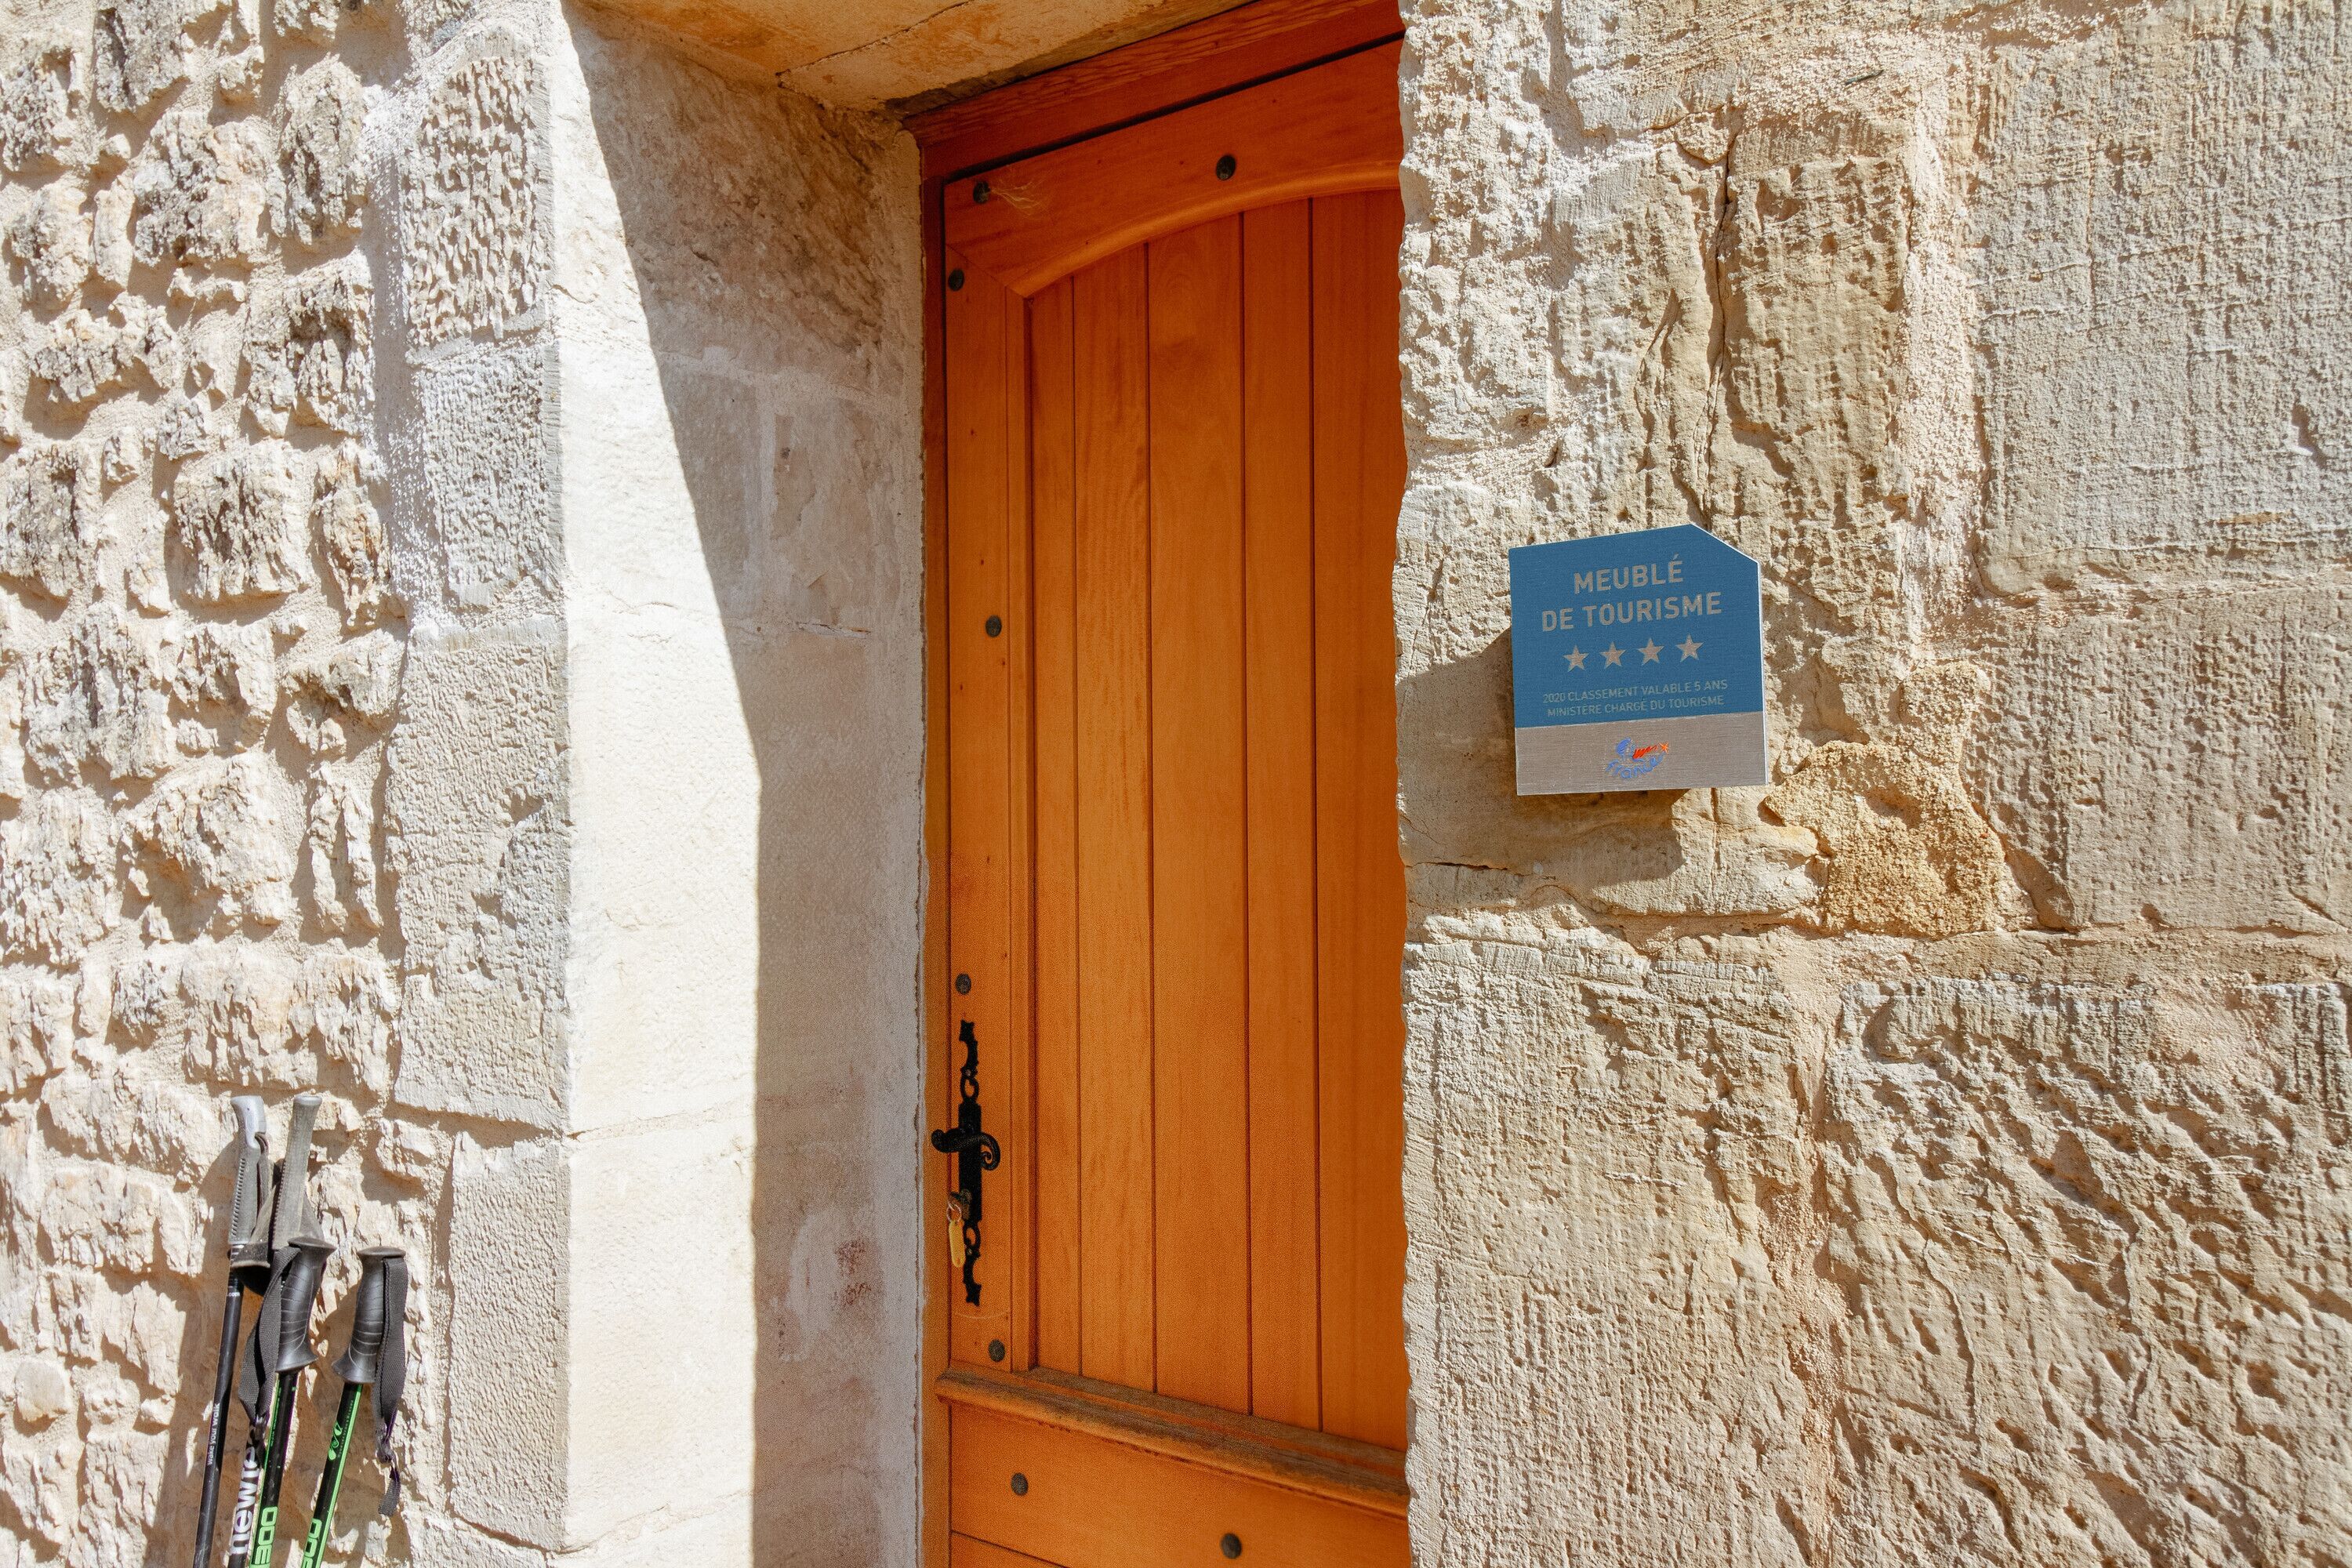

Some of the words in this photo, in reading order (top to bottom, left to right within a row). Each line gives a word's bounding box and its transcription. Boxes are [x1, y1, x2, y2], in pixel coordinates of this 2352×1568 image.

[1573, 554, 1683, 594] MEUBLÉ
[1542, 608, 1573, 632] DE
[1582, 591, 1722, 628] TOURISME
[1542, 692, 1565, 704] 2020
[1567, 686, 1638, 702] CLASSEMENT
[1642, 681, 1692, 695] VALABLE
[1694, 681, 1700, 691] 5
[1704, 679, 1728, 691] ANS
[1650, 699, 1665, 710] DU
[1668, 695, 1725, 709] TOURISME
[212, 1403, 220, 1427] walk
[209, 1427, 218, 1445] your
[206, 1446, 216, 1465] wake
[230, 1415, 267, 1555] newfe
[254, 1506, 278, 1565] 300
